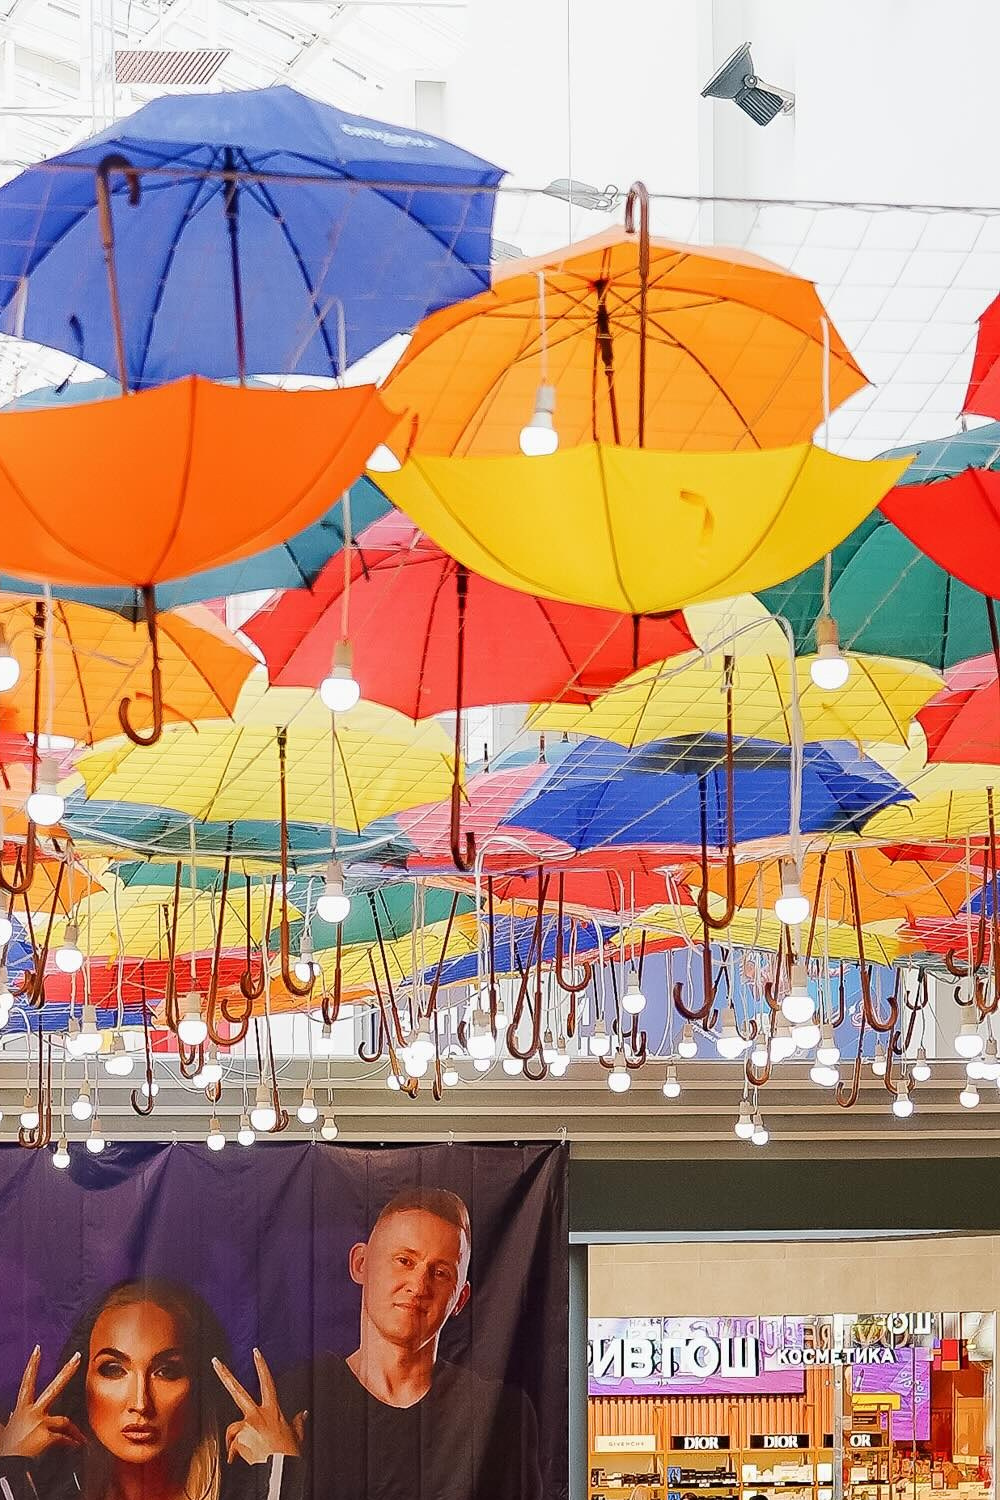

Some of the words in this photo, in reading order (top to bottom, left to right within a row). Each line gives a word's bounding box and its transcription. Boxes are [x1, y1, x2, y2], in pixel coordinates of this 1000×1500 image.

[777, 1348, 897, 1366] КОСМЕТИКА
[683, 1436, 719, 1450] DIOR
[763, 1436, 799, 1449] DIOR
